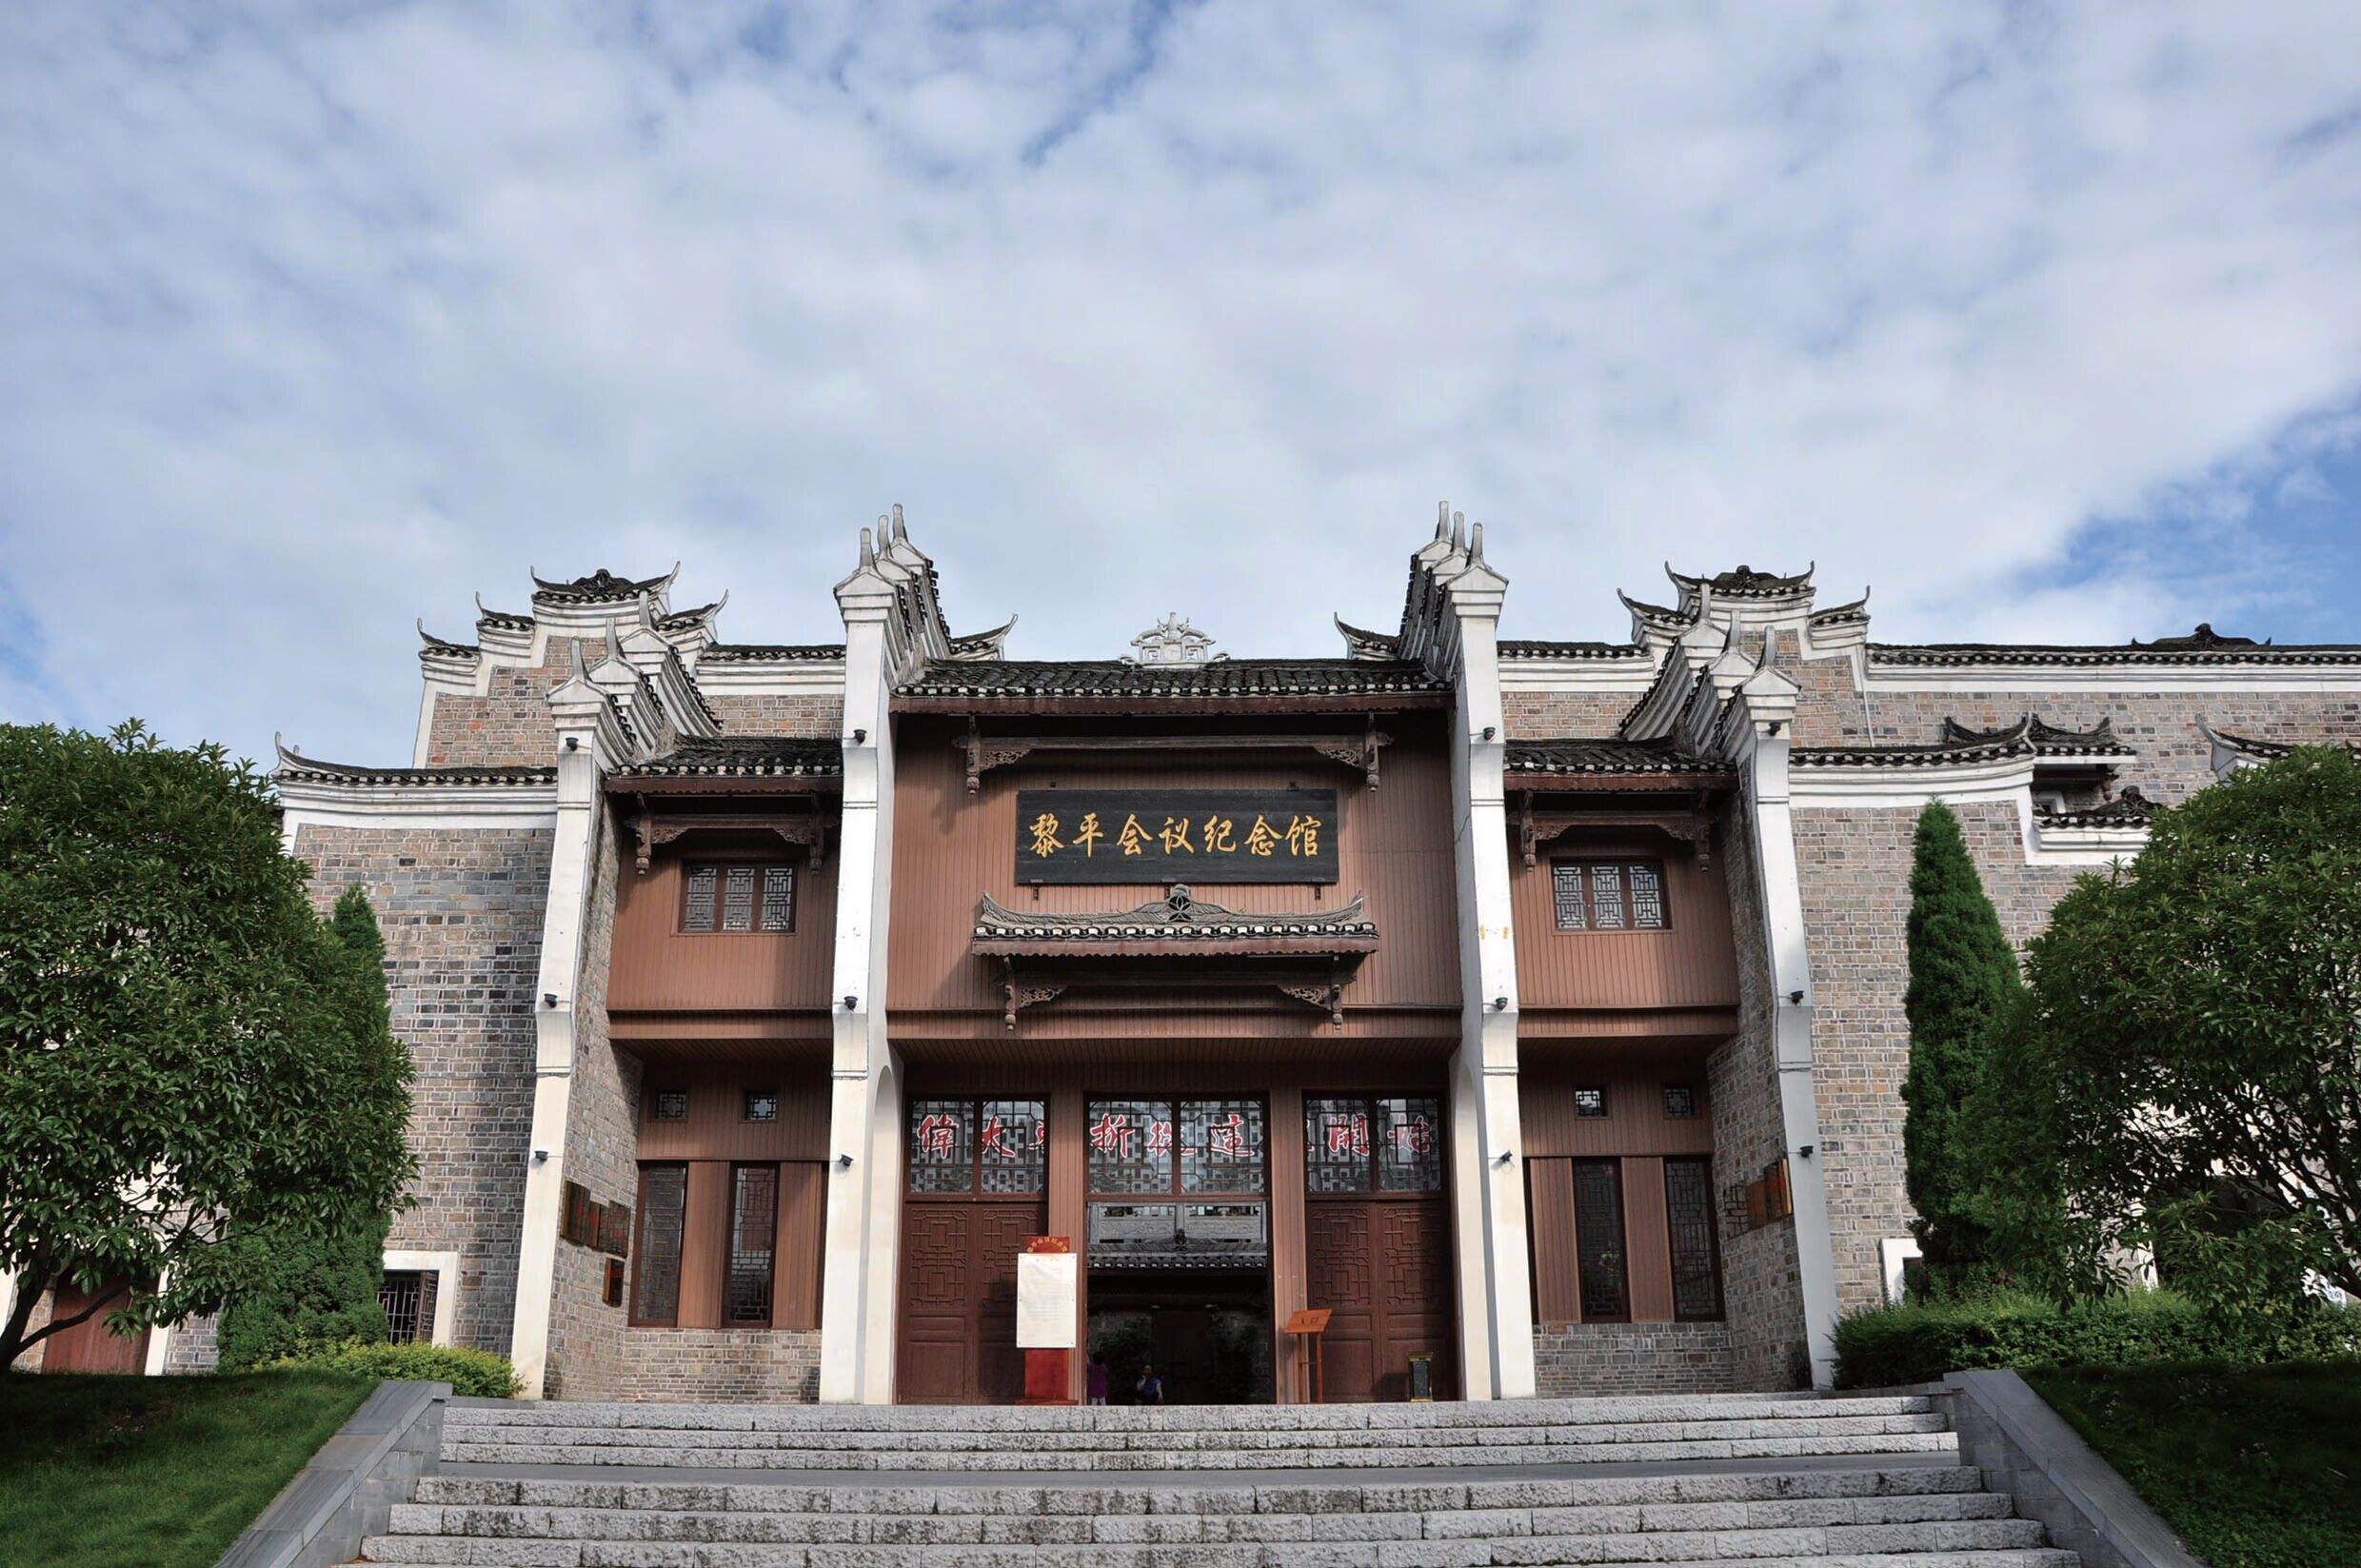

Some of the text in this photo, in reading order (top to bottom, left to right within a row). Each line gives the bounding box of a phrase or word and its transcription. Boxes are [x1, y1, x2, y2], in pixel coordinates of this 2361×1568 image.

[1029, 813, 1322, 857] 黎平会议纪念馆
